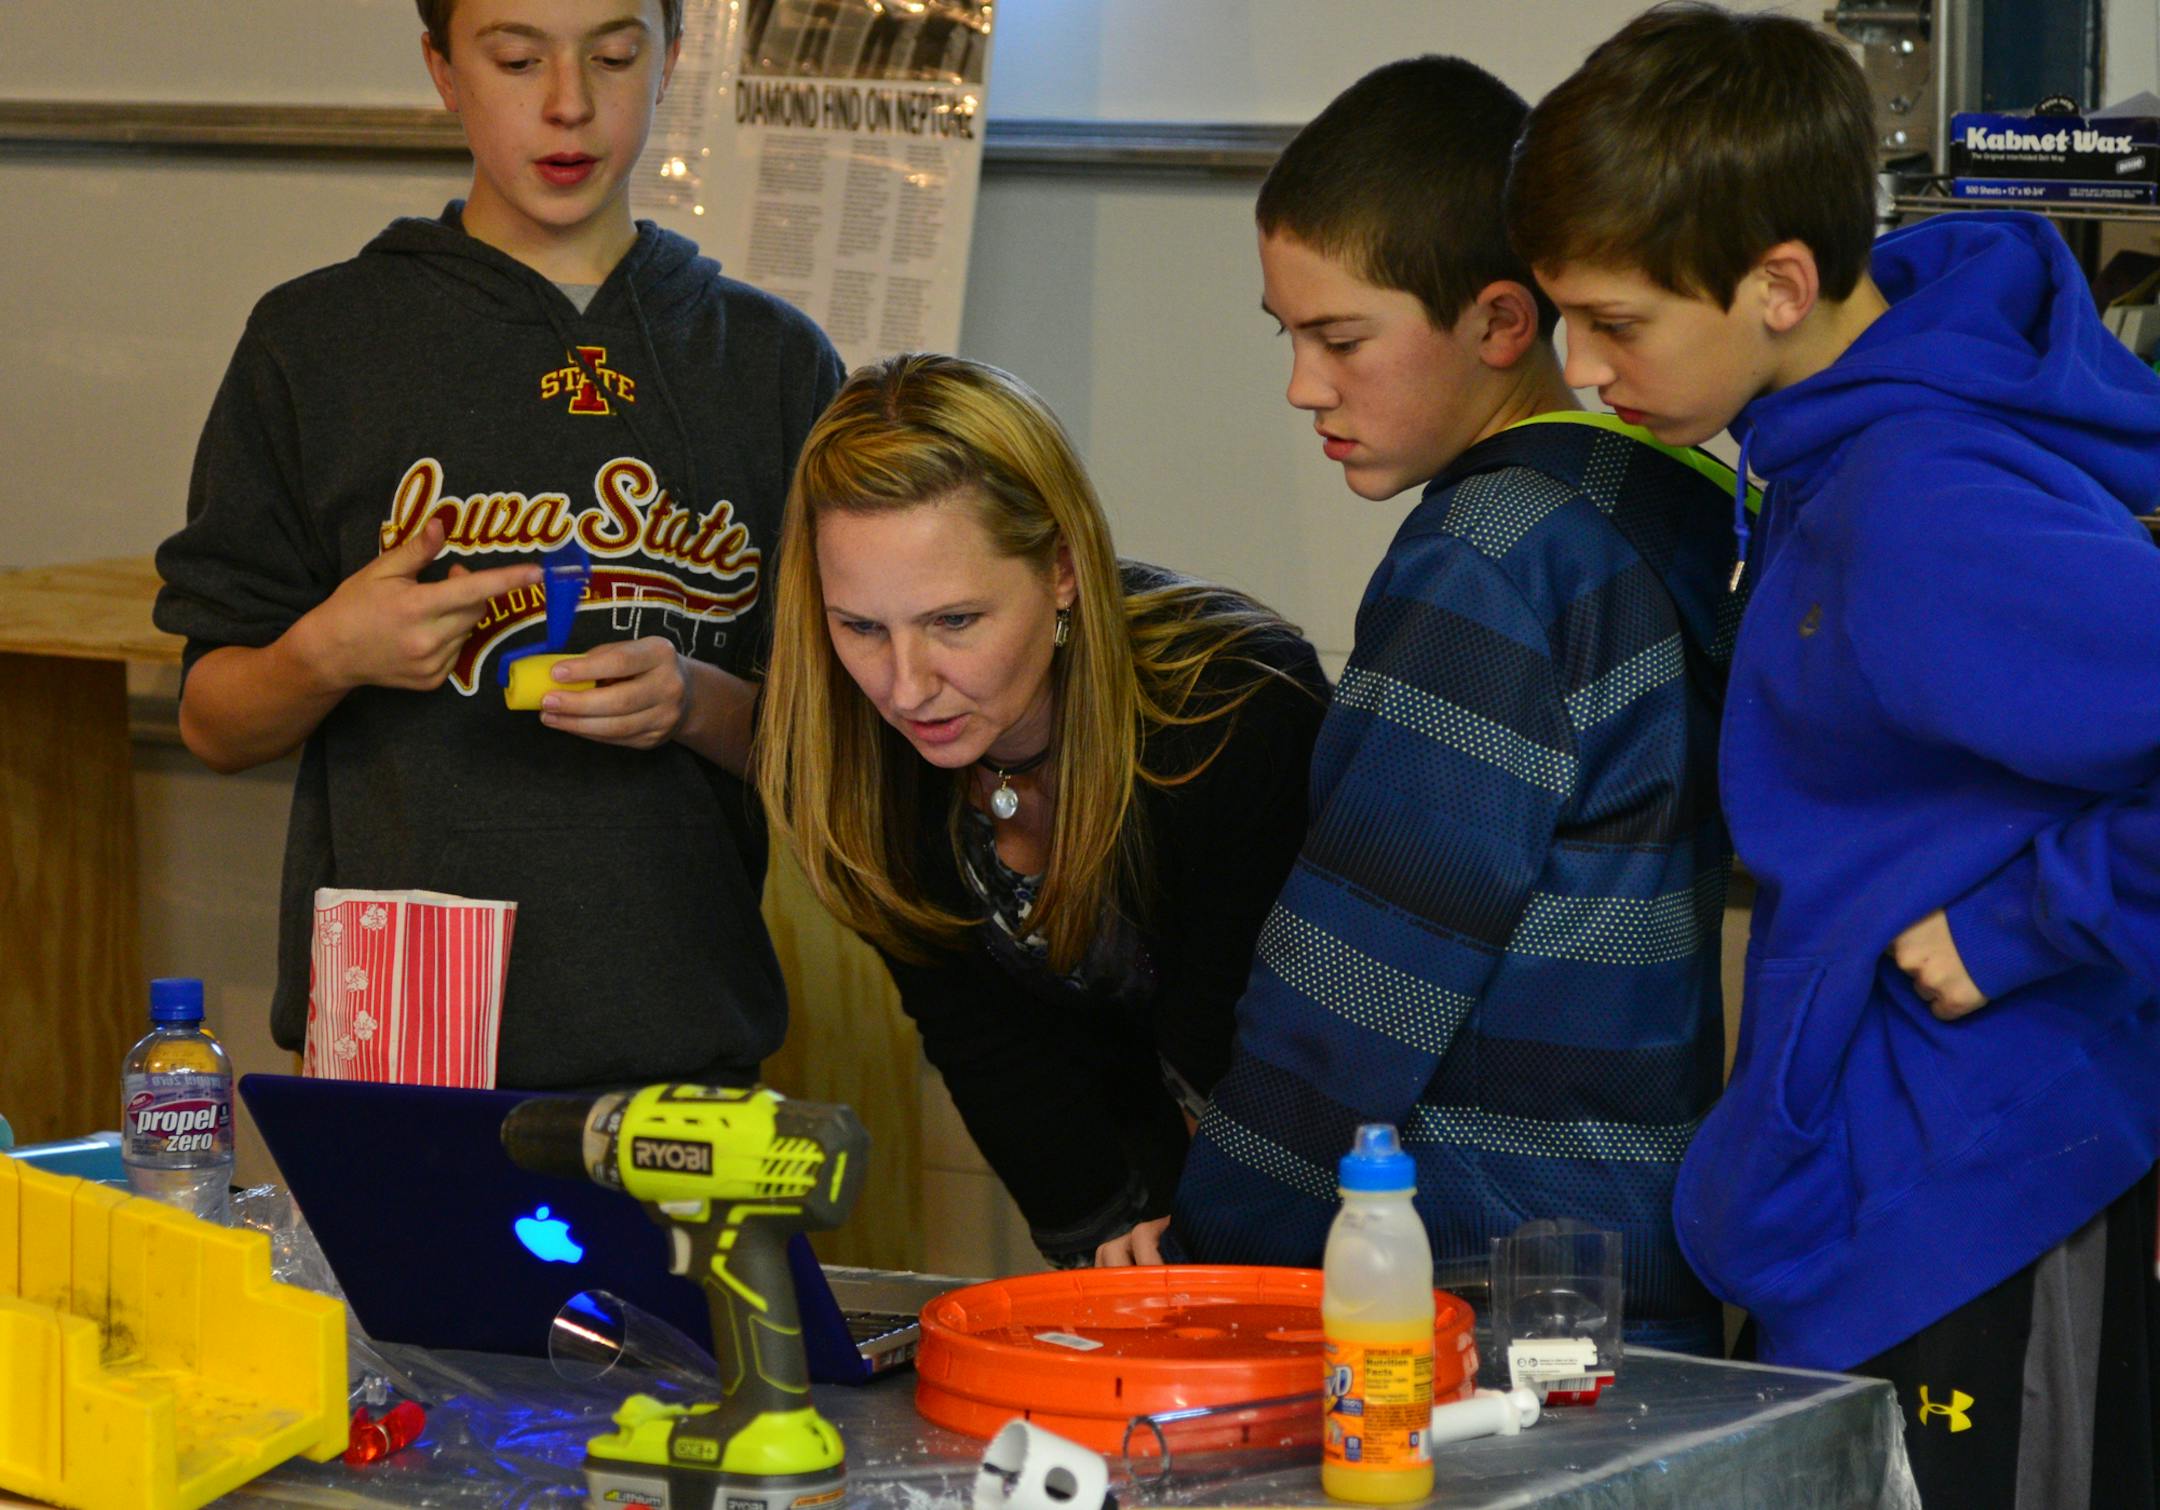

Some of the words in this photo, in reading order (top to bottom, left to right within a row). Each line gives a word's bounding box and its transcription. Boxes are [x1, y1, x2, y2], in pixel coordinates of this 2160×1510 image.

[736, 79, 817, 128] DIAMOND
[823, 84, 861, 131] FIND
[866, 87, 893, 133] ON
[1966, 127, 2069, 151] Kabnet
[2072, 129, 2133, 154] Wax
[541, 366, 636, 403] STATE
[379, 457, 573, 558] Iowa
[575, 457, 761, 581] State
[136, 1104, 217, 1135] propel
[166, 1133, 213, 1152] zero
[633, 1141, 711, 1171] RYOBI
